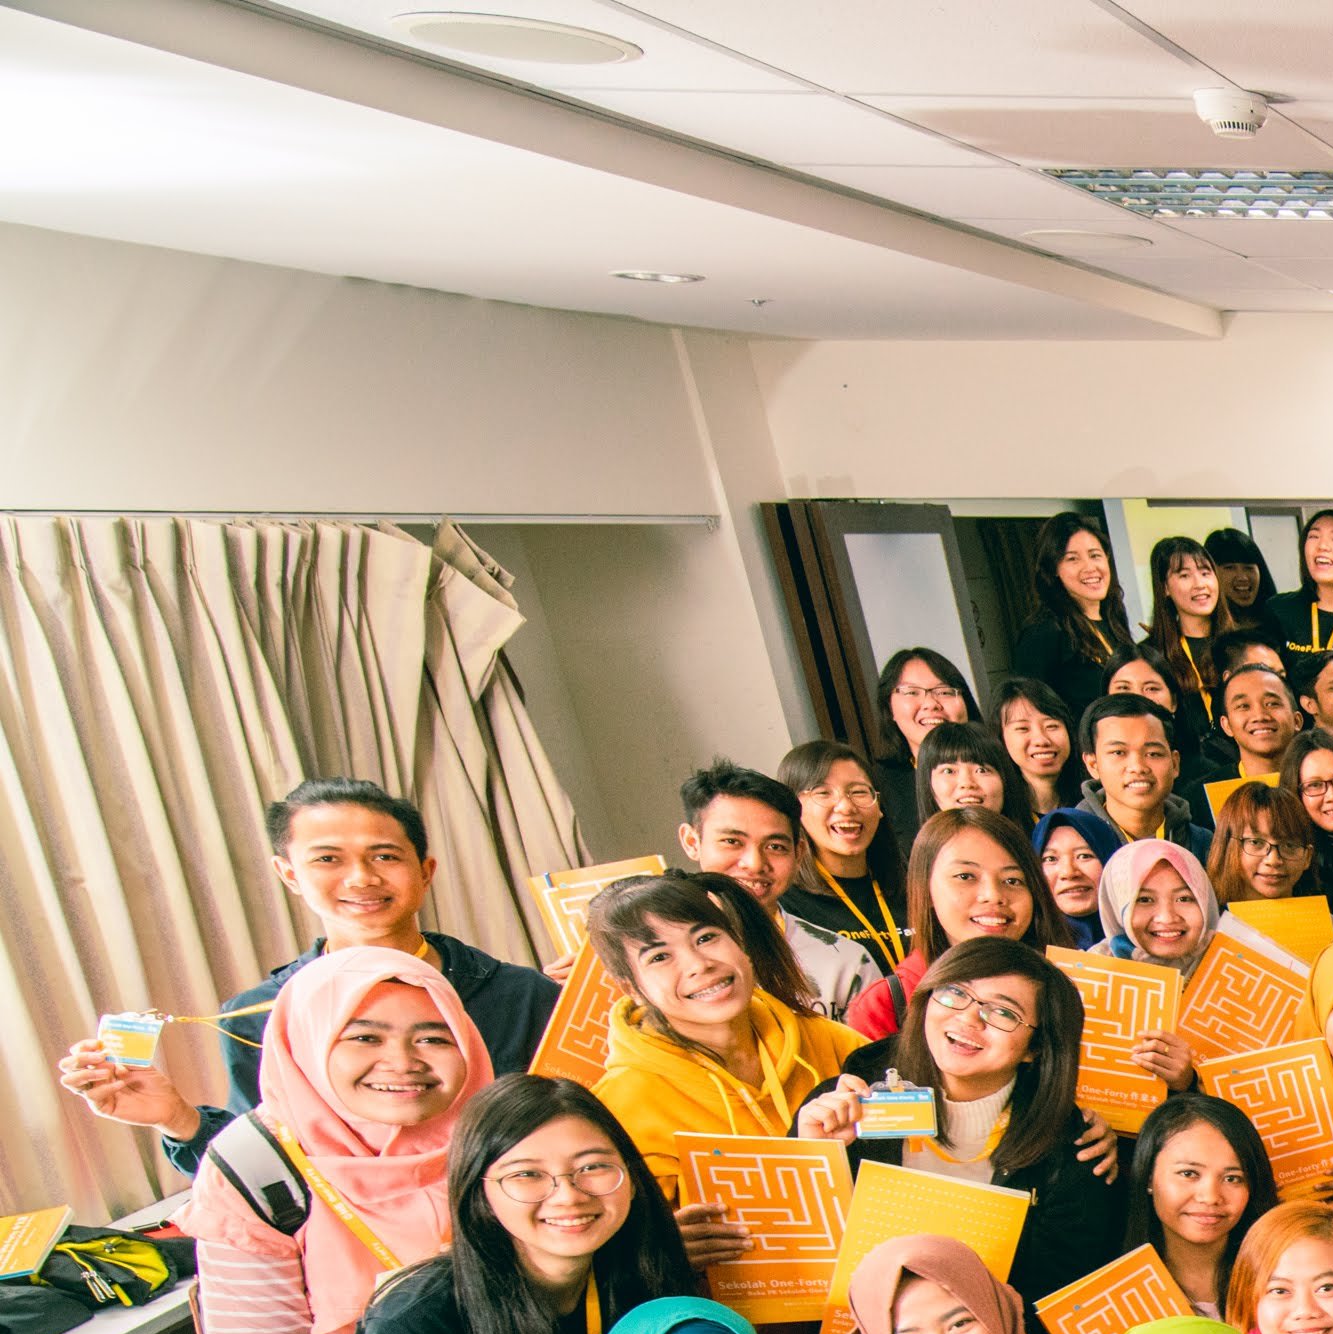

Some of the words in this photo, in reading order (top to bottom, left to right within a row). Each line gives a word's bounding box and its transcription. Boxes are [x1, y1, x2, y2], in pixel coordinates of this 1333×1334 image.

[1081, 1084, 1128, 1098] One-Forty
[1278, 1162, 1320, 1179] One-Forty
[718, 1280, 767, 1291] Sekolah
[770, 1278, 829, 1290] One-Forty
